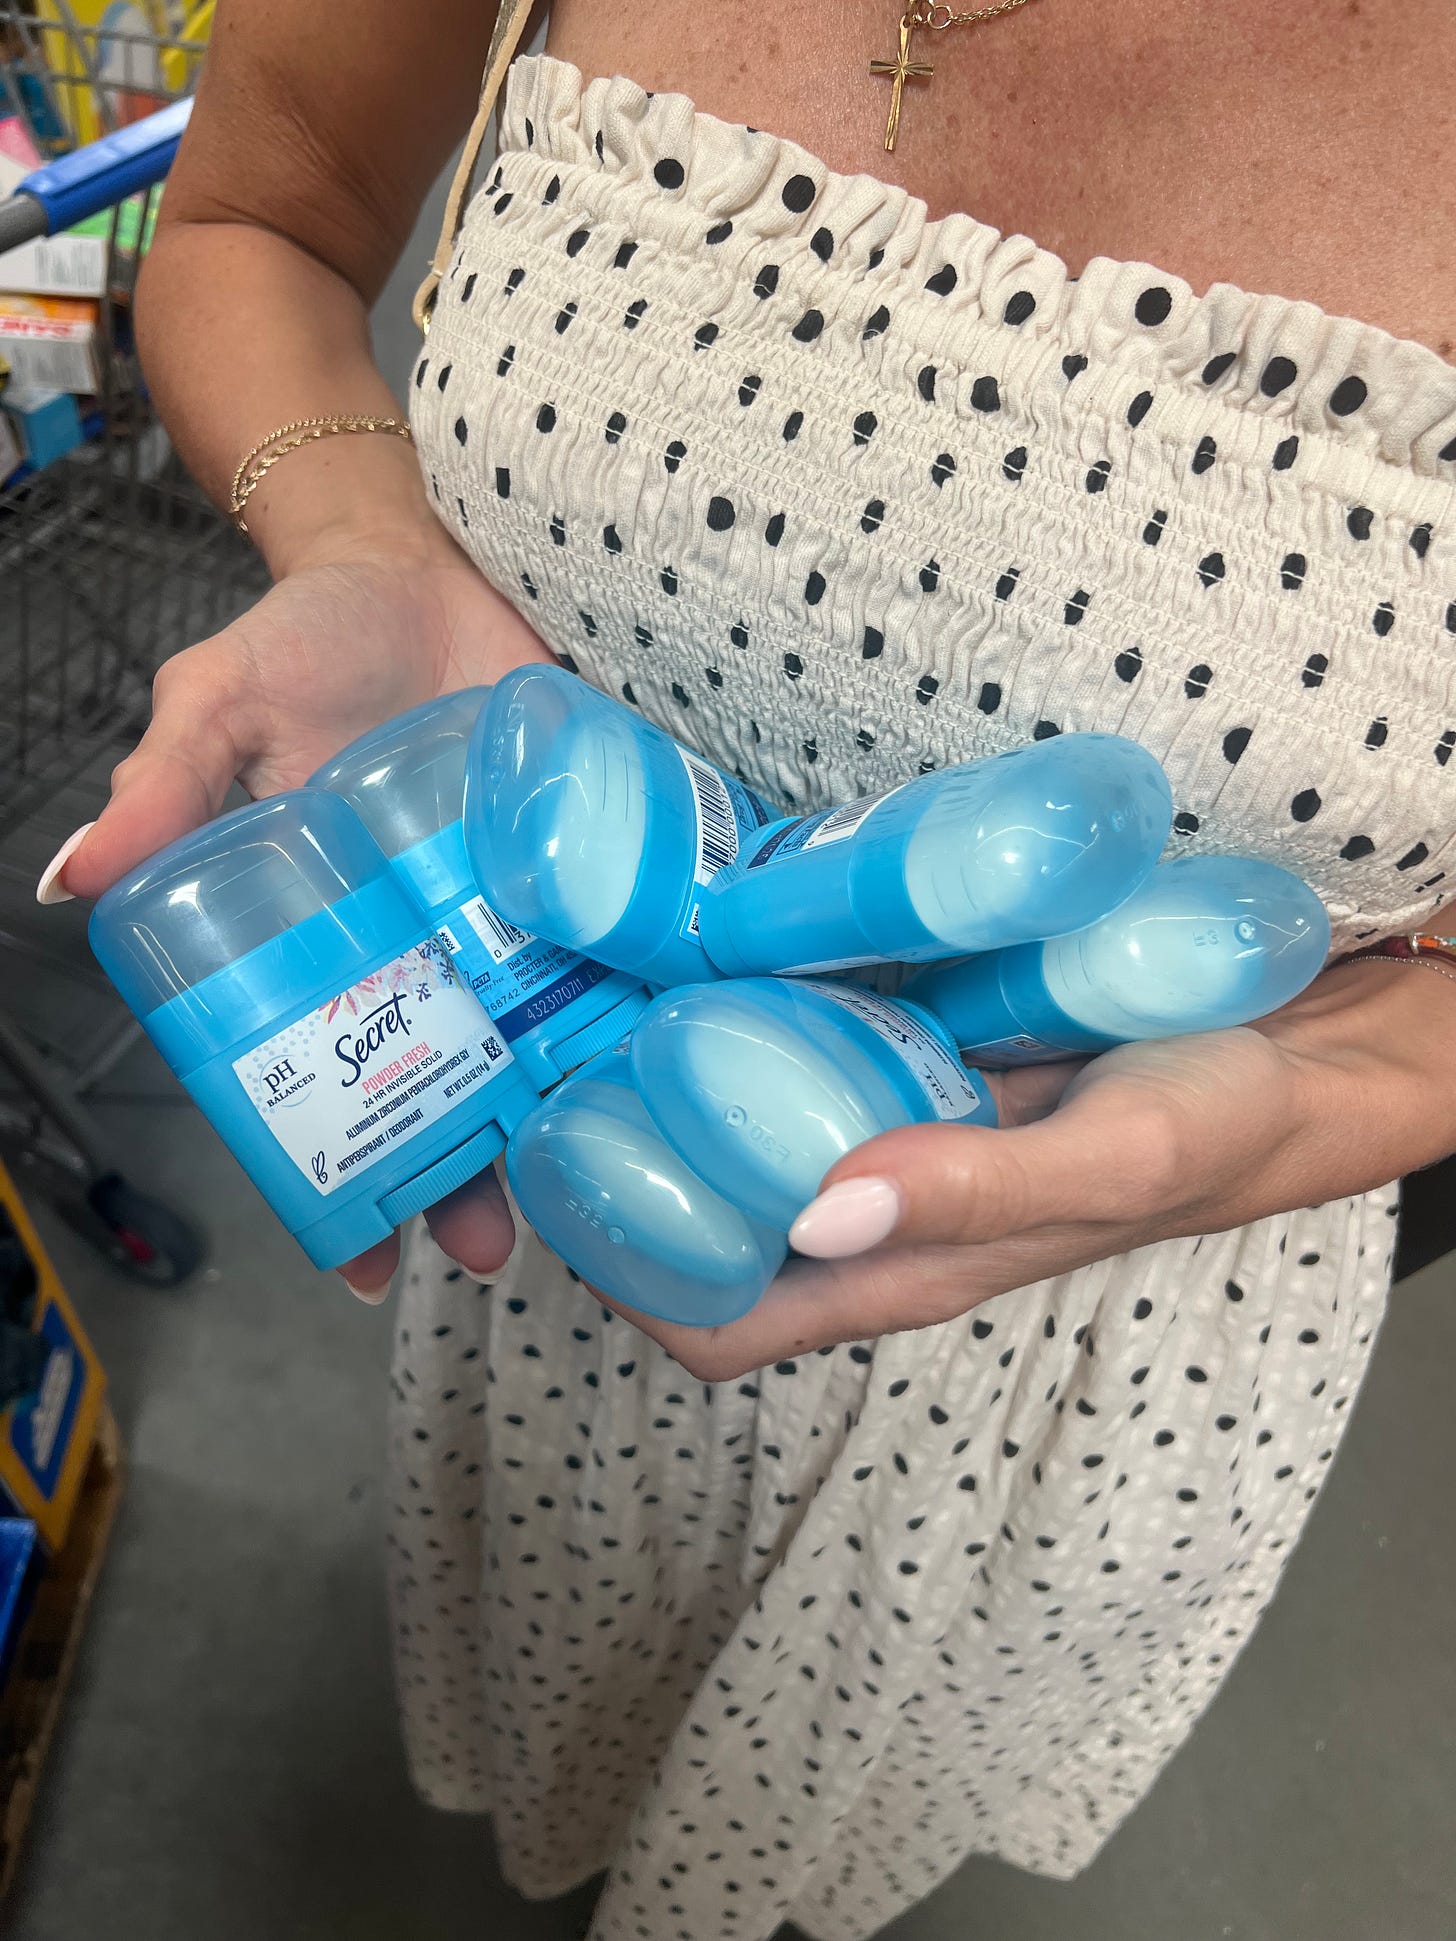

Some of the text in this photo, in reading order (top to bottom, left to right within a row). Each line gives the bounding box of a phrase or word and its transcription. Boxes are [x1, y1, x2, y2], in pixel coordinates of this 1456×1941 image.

[513, 956, 544, 981] PROCTER
[542, 953, 550, 963] &
[521, 951, 533, 965] by
[472, 973, 490, 989] PETA
[520, 963, 560, 991] CINCINNATI,
[334, 992, 411, 1088] Secret
[263, 1059, 297, 1094] pH
[361, 1041, 431, 1095] POWDER FRESH
[362, 1050, 443, 1109] 24 HR INVISIBLE SOLID
[266, 1072, 317, 1108] BALANCED
[443, 1086, 456, 1099] NET
[461, 1073, 473, 1087] 0.5
[345, 1112, 381, 1141] ALUMINUM
[377, 1091, 410, 1120] ZIRCONIUM
[337, 1133, 388, 1173] ANTIPERSPIRANT
[389, 1108, 424, 1138] DEODORANT
